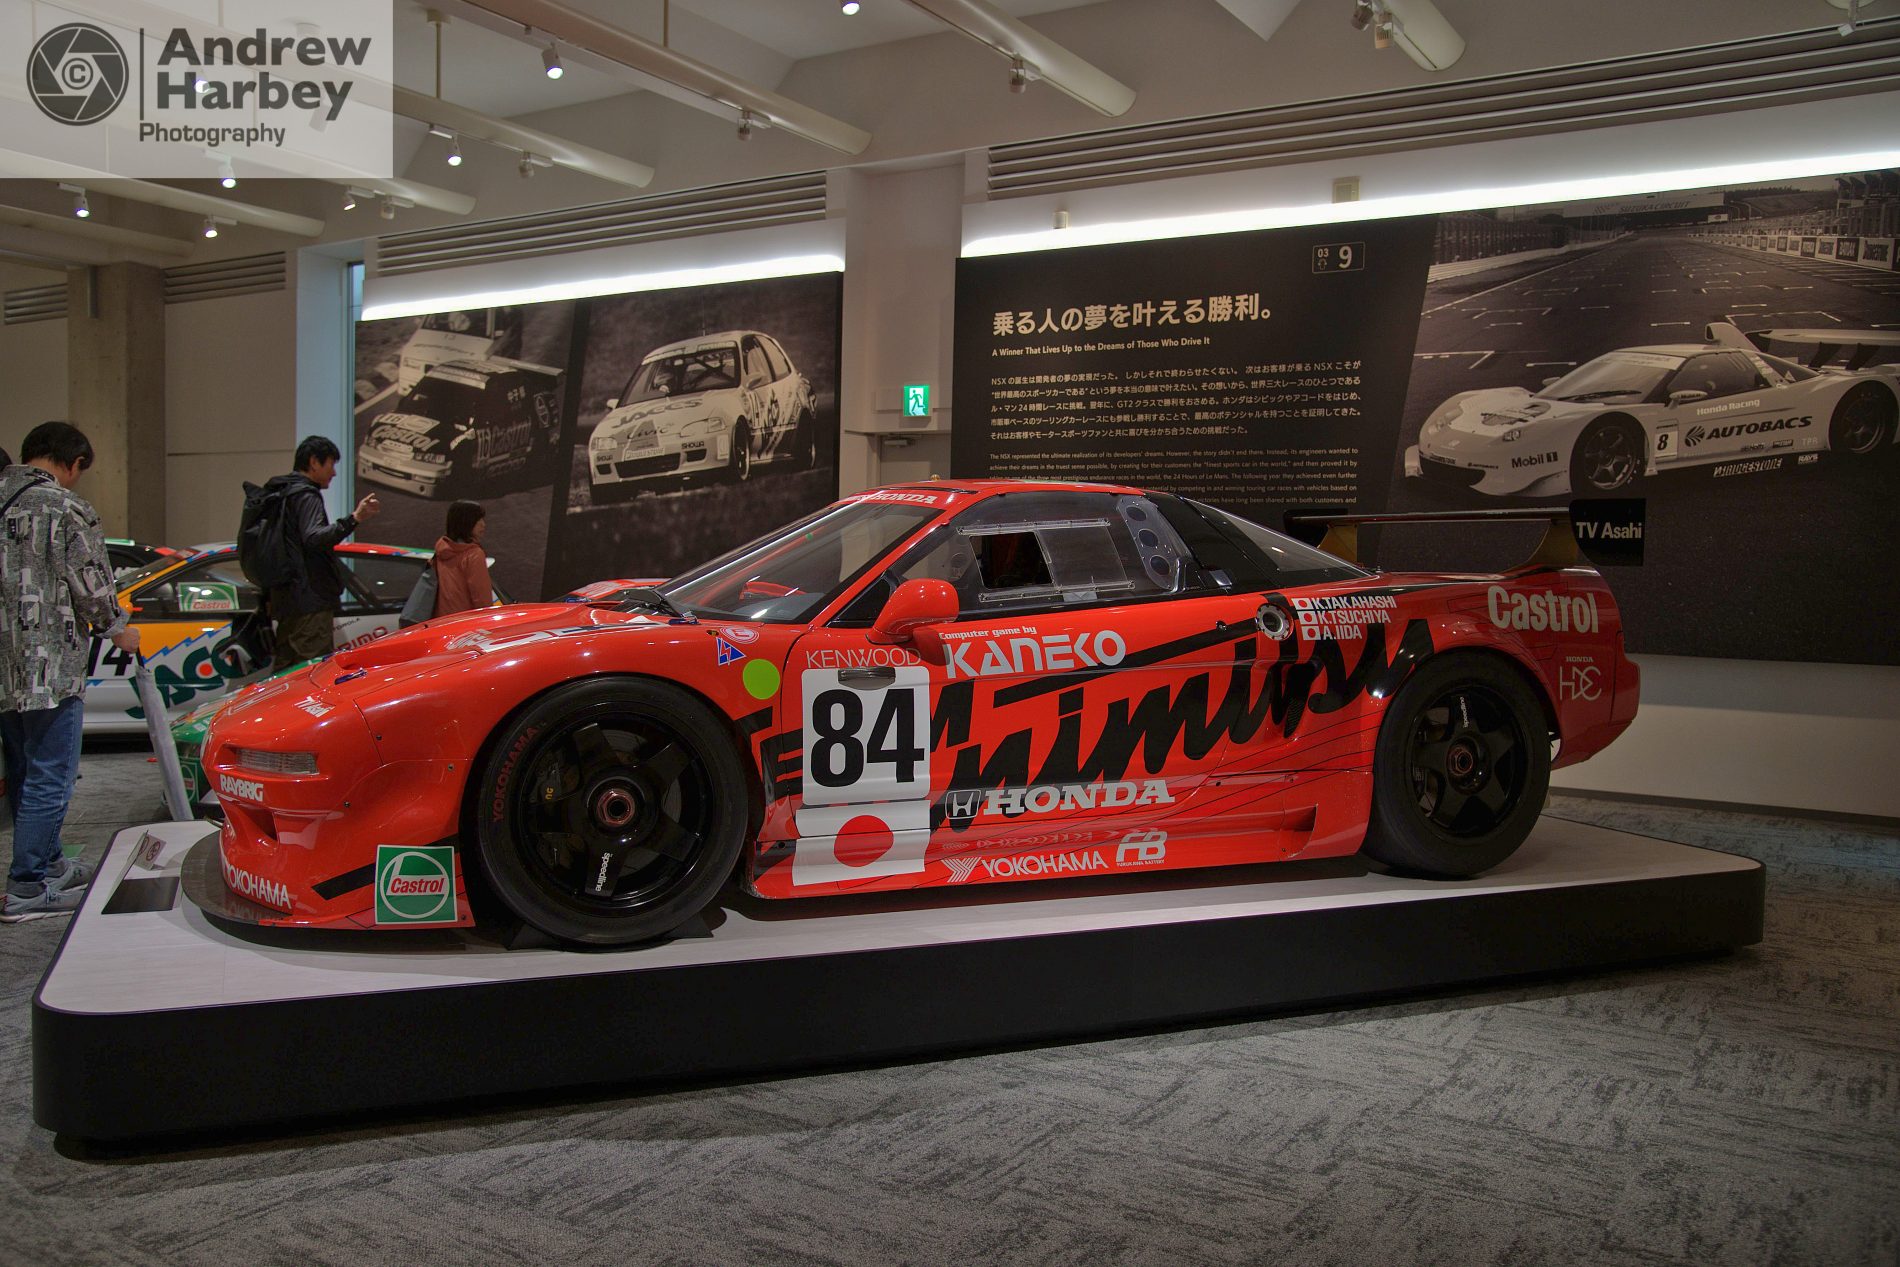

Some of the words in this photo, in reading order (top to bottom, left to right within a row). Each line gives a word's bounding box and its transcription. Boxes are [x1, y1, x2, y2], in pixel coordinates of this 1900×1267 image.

[1317, 247, 1329, 258] 03
[1339, 245, 1352, 269] 9
[992, 293, 1273, 337] 乗る人の夢を叶える勝利。
[991, 348, 997, 356] A
[999, 346, 1023, 355] Winner
[1024, 345, 1040, 354] That
[1041, 344, 1060, 353] Lives
[1061, 344, 1072, 354] Up
[1074, 343, 1082, 351] to
[1083, 342, 1095, 351] the
[1097, 341, 1124, 350] Dreams
[1126, 340, 1134, 349] of
[1136, 339, 1159, 348] Those
[1160, 338, 1178, 347] Who
[1180, 337, 1201, 346] Drive
[1203, 336, 1210, 344] It
[612, 398, 704, 429] JACCS
[1696, 404, 1728, 416] Honda
[1728, 398, 1760, 410] Racing
[1706, 416, 1813, 440] AUTOBACS
[1657, 433, 1669, 451] 8
[1511, 454, 1544, 468] Mobil
[1575, 522, 1599, 539] TV
[1600, 521, 1642, 539] Asahi
[193, 599, 231, 611] Castrol
[1311, 595, 1397, 610] K.TAKAHASHI
[1487, 585, 1599, 633] Castrol
[1316, 609, 1392, 625] K.TSUCHIYA
[939, 629, 989, 641] Computer
[992, 626, 1021, 638] game
[1022, 625, 1036, 635] by
[1322, 624, 1363, 640] A.IIDA
[88, 631, 134, 676] 14
[806, 647, 921, 669] KENWOOD
[942, 629, 1126, 679] KANEKO
[810, 687, 925, 788] 84
[493, 726, 537, 823] YOKOHAMA
[219, 774, 264, 801] RAYBRIG
[983, 780, 1175, 816] HONDA
[595, 852, 614, 892] speedline
[981, 850, 1109, 878] YOKOHAMA
[225, 863, 292, 909] YOKOHAMA
[390, 876, 445, 894] Castrol
